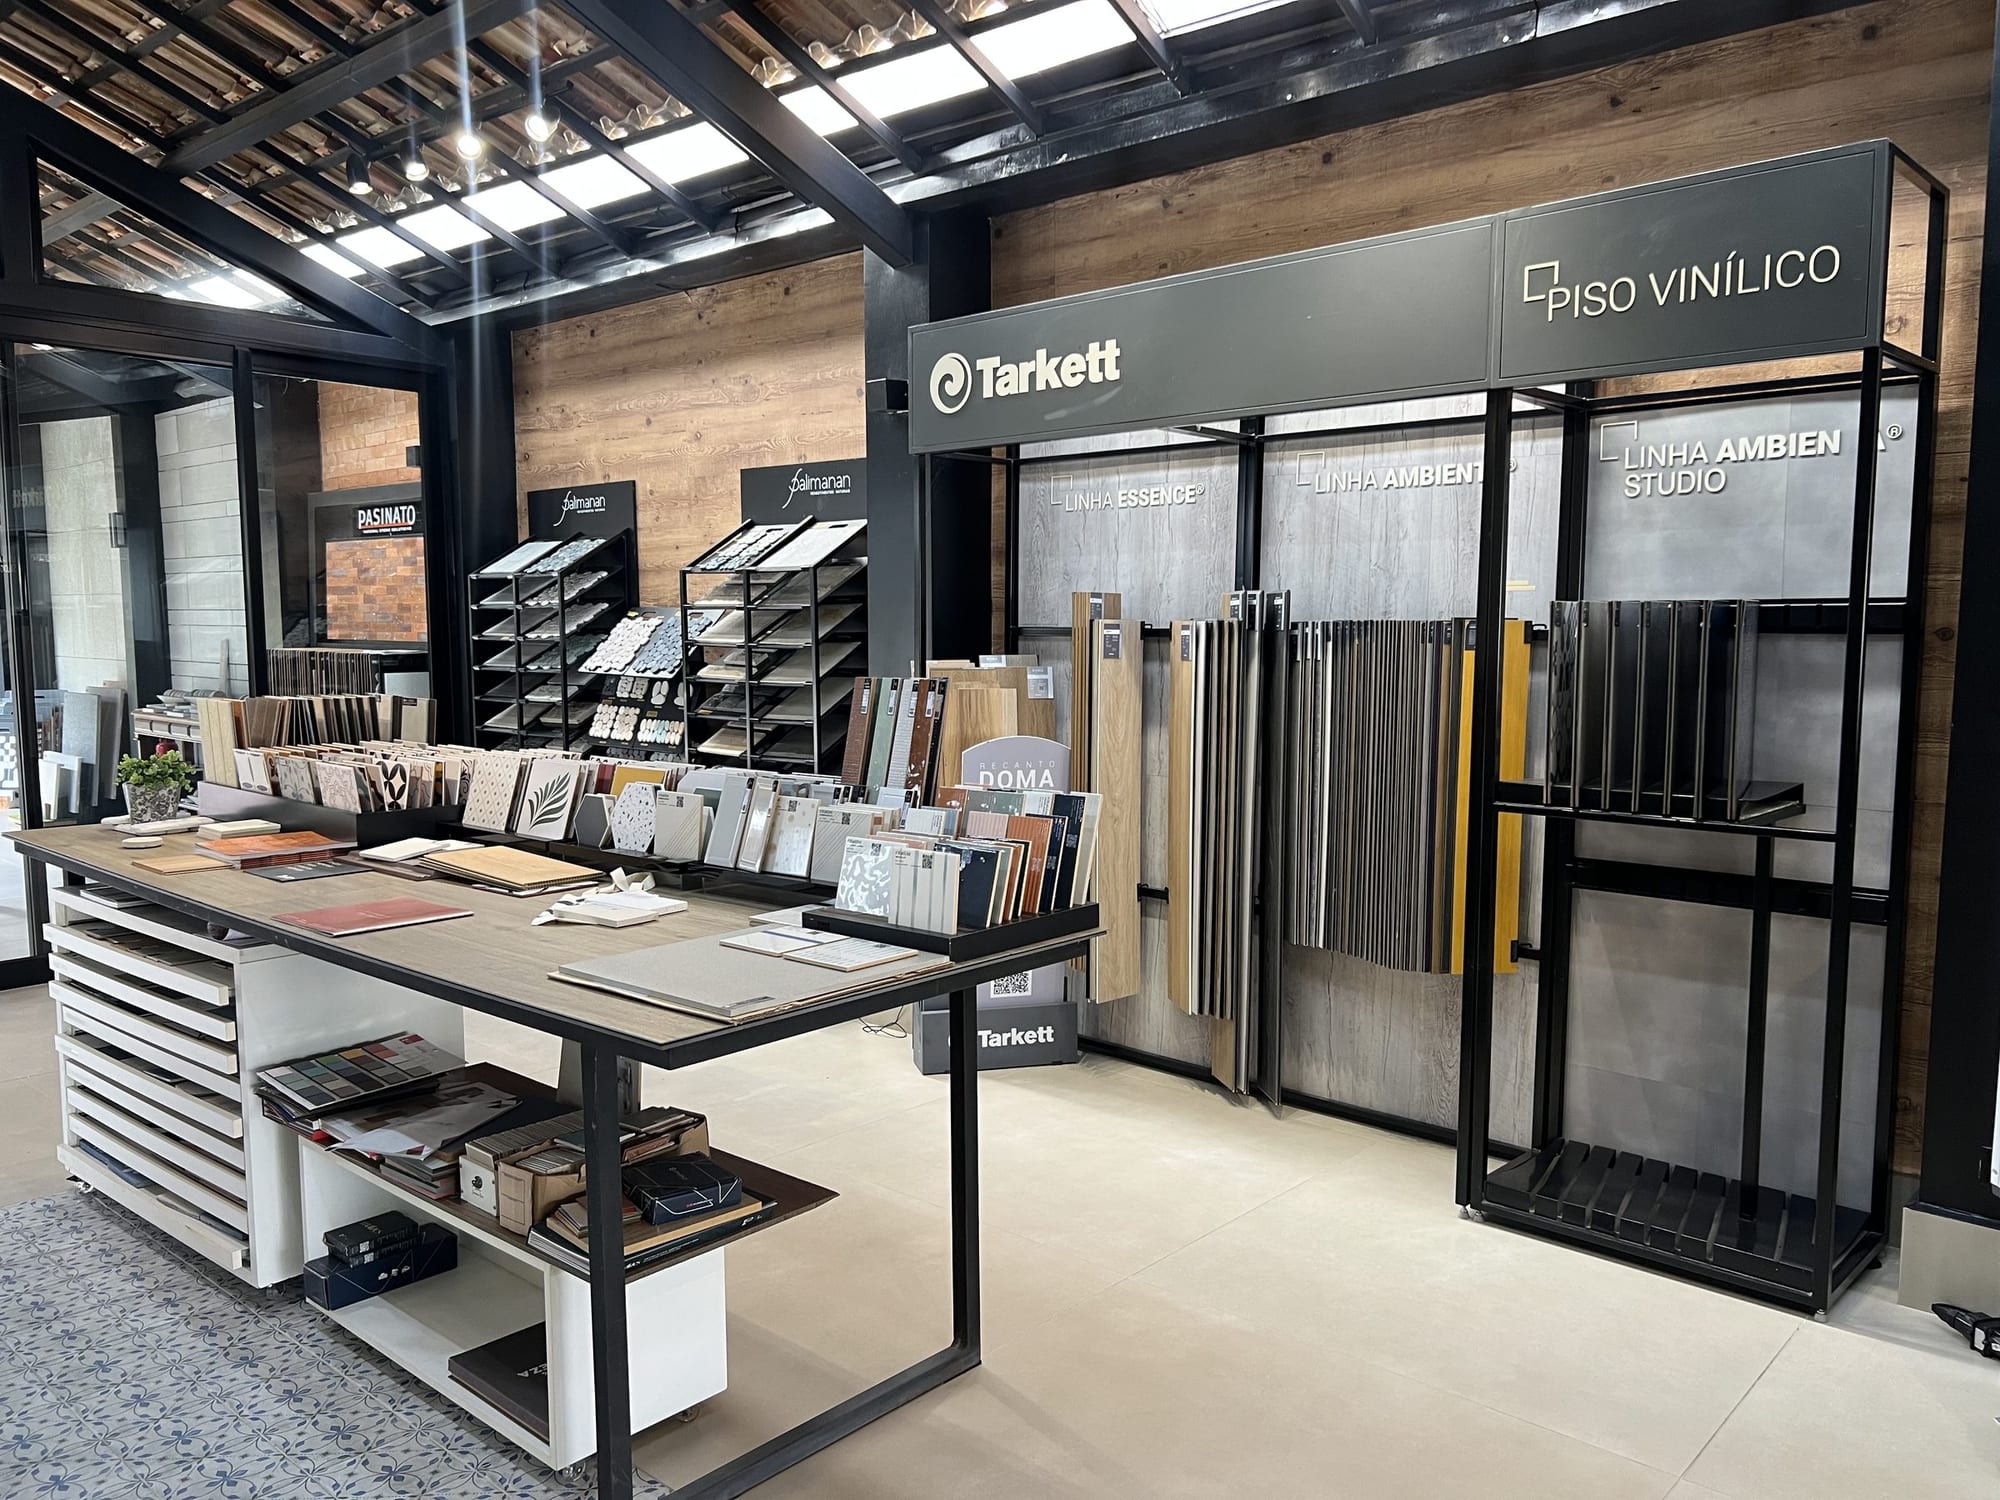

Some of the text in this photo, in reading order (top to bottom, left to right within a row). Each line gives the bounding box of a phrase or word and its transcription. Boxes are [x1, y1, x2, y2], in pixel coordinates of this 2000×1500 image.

[1547, 244, 1841, 323] PISO VINÍLICO
[975, 338, 1121, 399] Tarkett
[1624, 440, 1709, 471] LINHA
[1314, 469, 1379, 495] LINHA
[1624, 467, 1727, 499] STUDIO
[1064, 491, 1114, 513] LINHA
[357, 504, 416, 530] PASINATO
[978, 760, 1056, 771] RECANTO
[978, 768, 1055, 789] DOMA
[976, 1025, 1055, 1049] Tarkett
